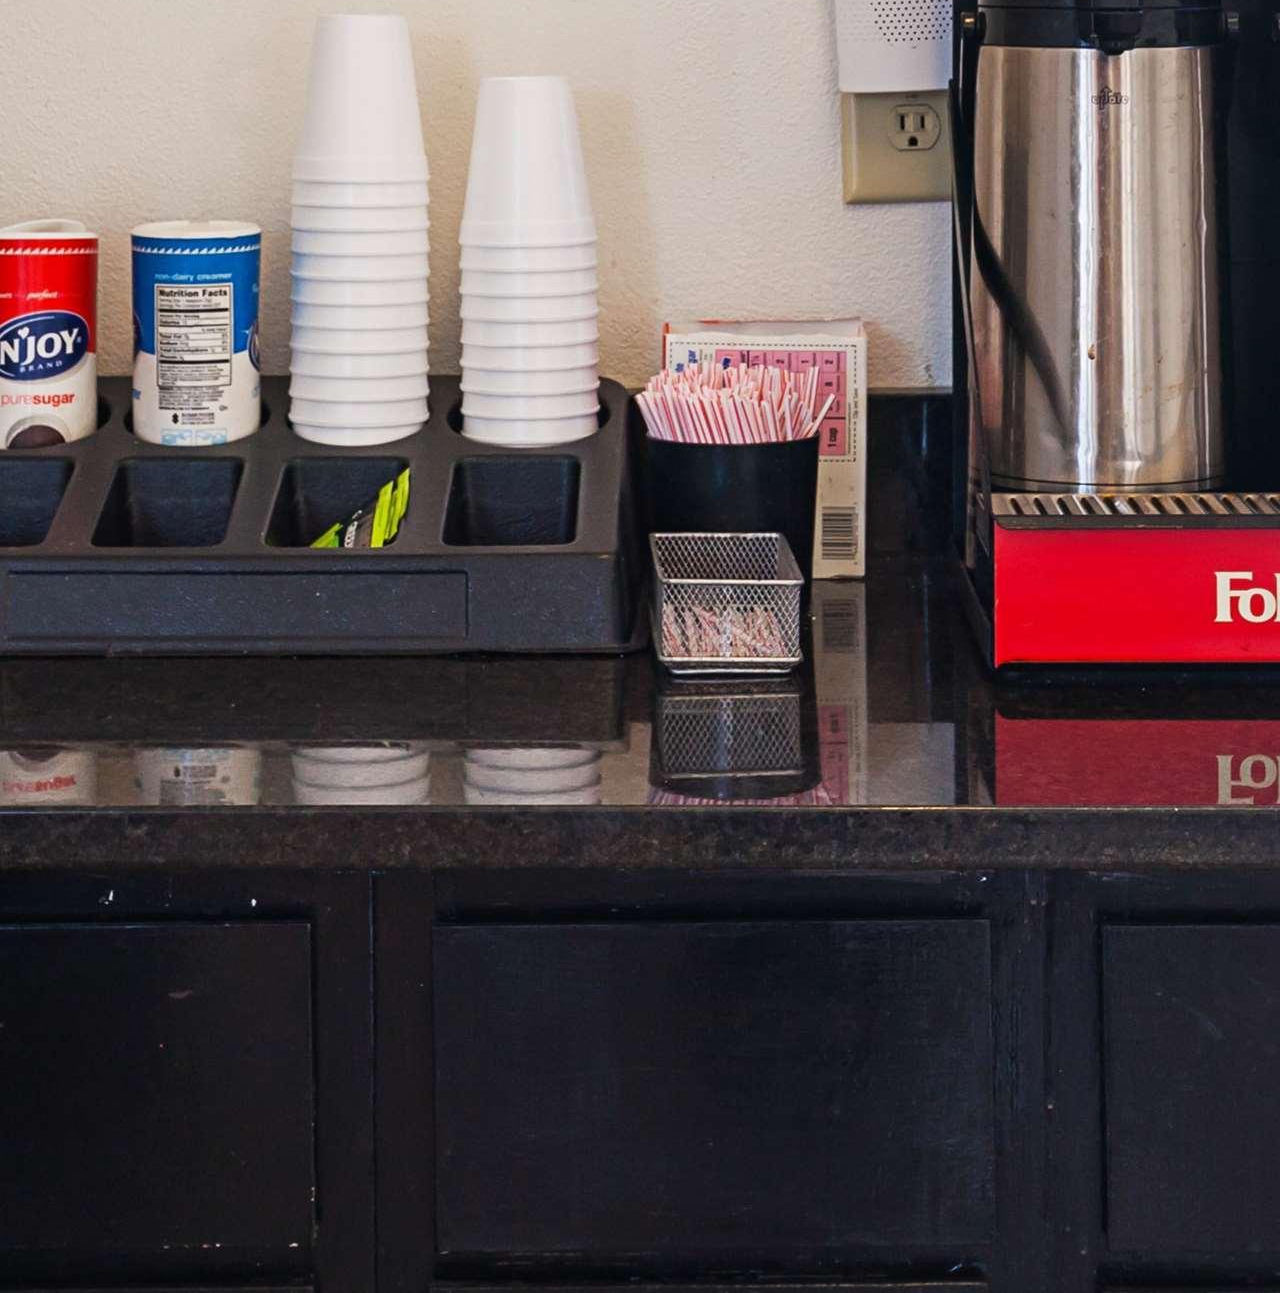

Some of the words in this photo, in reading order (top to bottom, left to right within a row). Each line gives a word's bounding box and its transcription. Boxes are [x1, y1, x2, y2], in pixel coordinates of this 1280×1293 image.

[159, 289, 199, 298] Nutrition
[202, 289, 227, 298] Facts
[19, 360, 63, 373] BRAND
